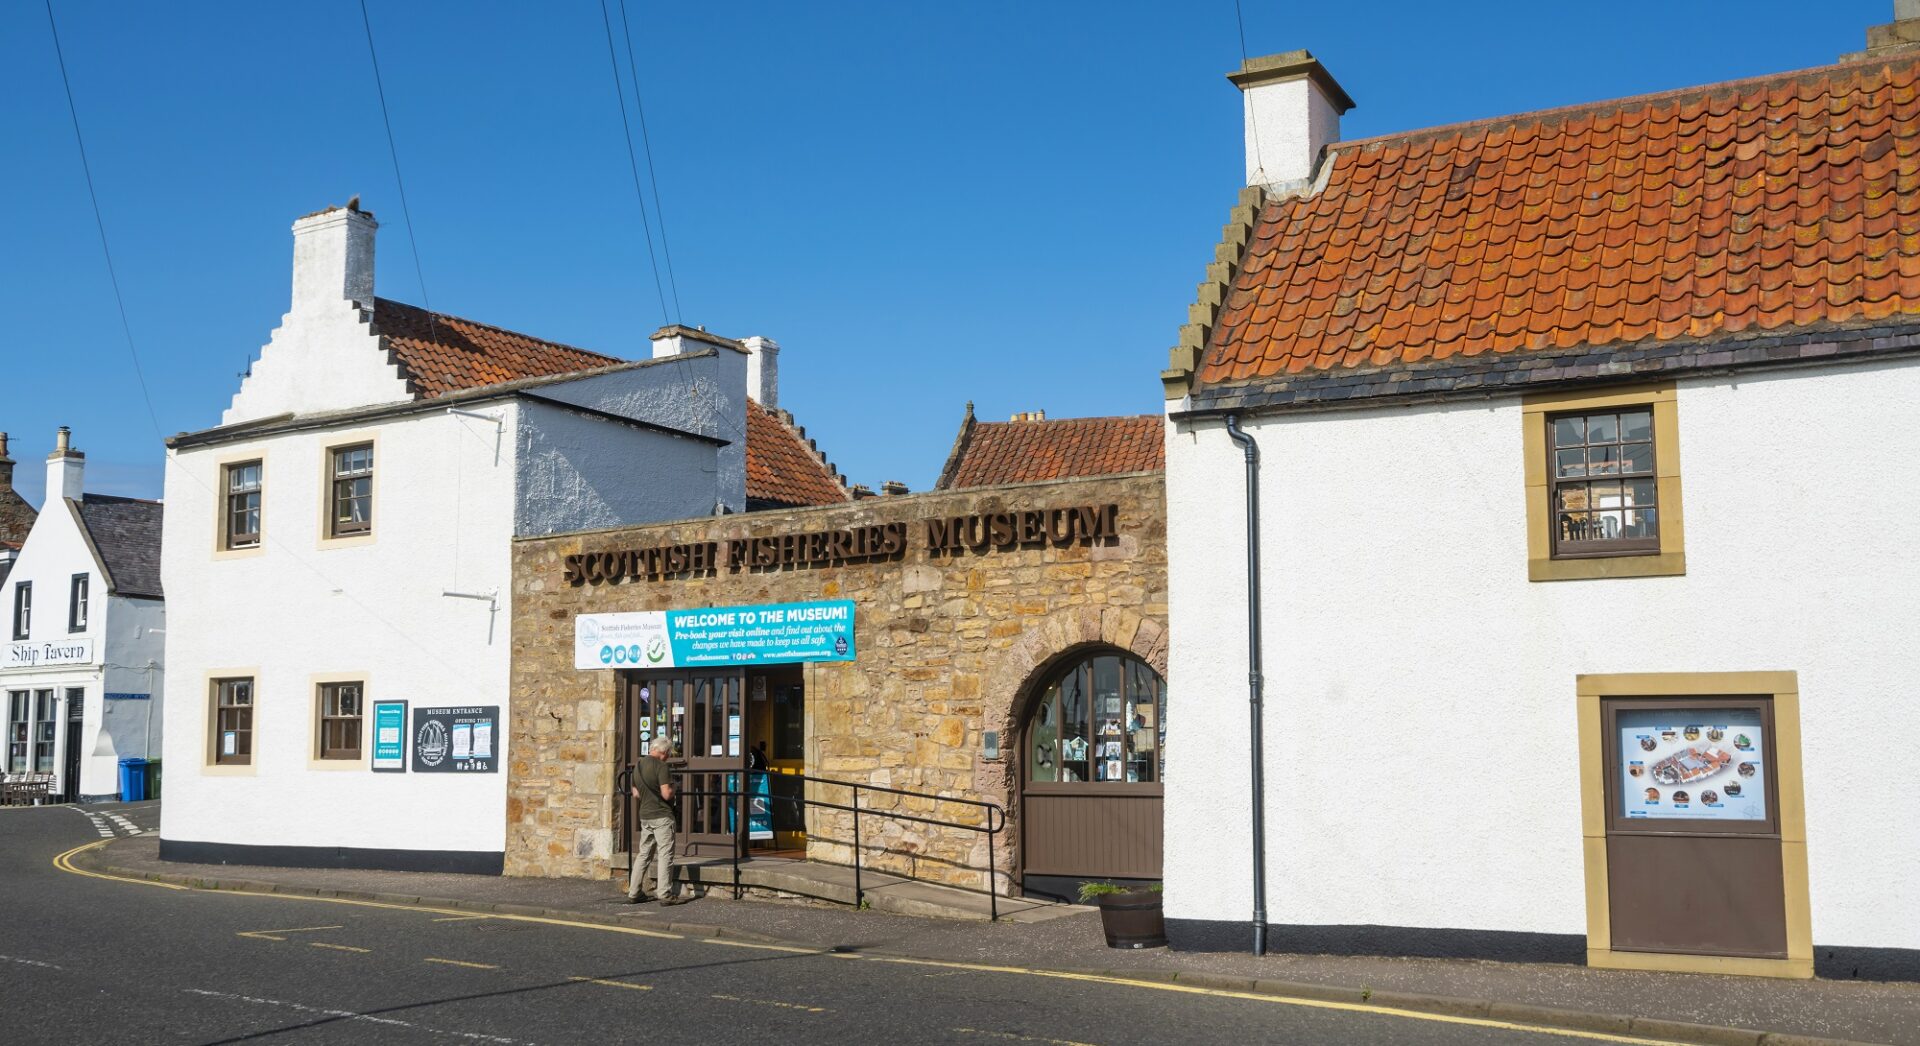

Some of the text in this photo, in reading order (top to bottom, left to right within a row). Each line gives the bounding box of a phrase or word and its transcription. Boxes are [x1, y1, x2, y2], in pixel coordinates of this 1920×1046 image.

[563, 504, 1117, 582] SCOTTISH FISHERIES MUSEUM
[602, 623, 663, 632] Scottish Fisheries Museum
[674, 606, 848, 628] WELCOME TO THE MUSEUM!
[674, 622, 846, 644] Pre-book your visit online and find out about the
[692, 639, 719, 652] changes
[719, 640, 730, 649] we
[730, 637, 746, 648] have
[746, 636, 767, 647] made
[767, 637, 775, 646] to
[775, 636, 791, 649] keep
[791, 637, 800, 646] us
[800, 635, 810, 645] all
[810, 634, 827, 647] safe
[11, 643, 84, 664] Ship Tavern
